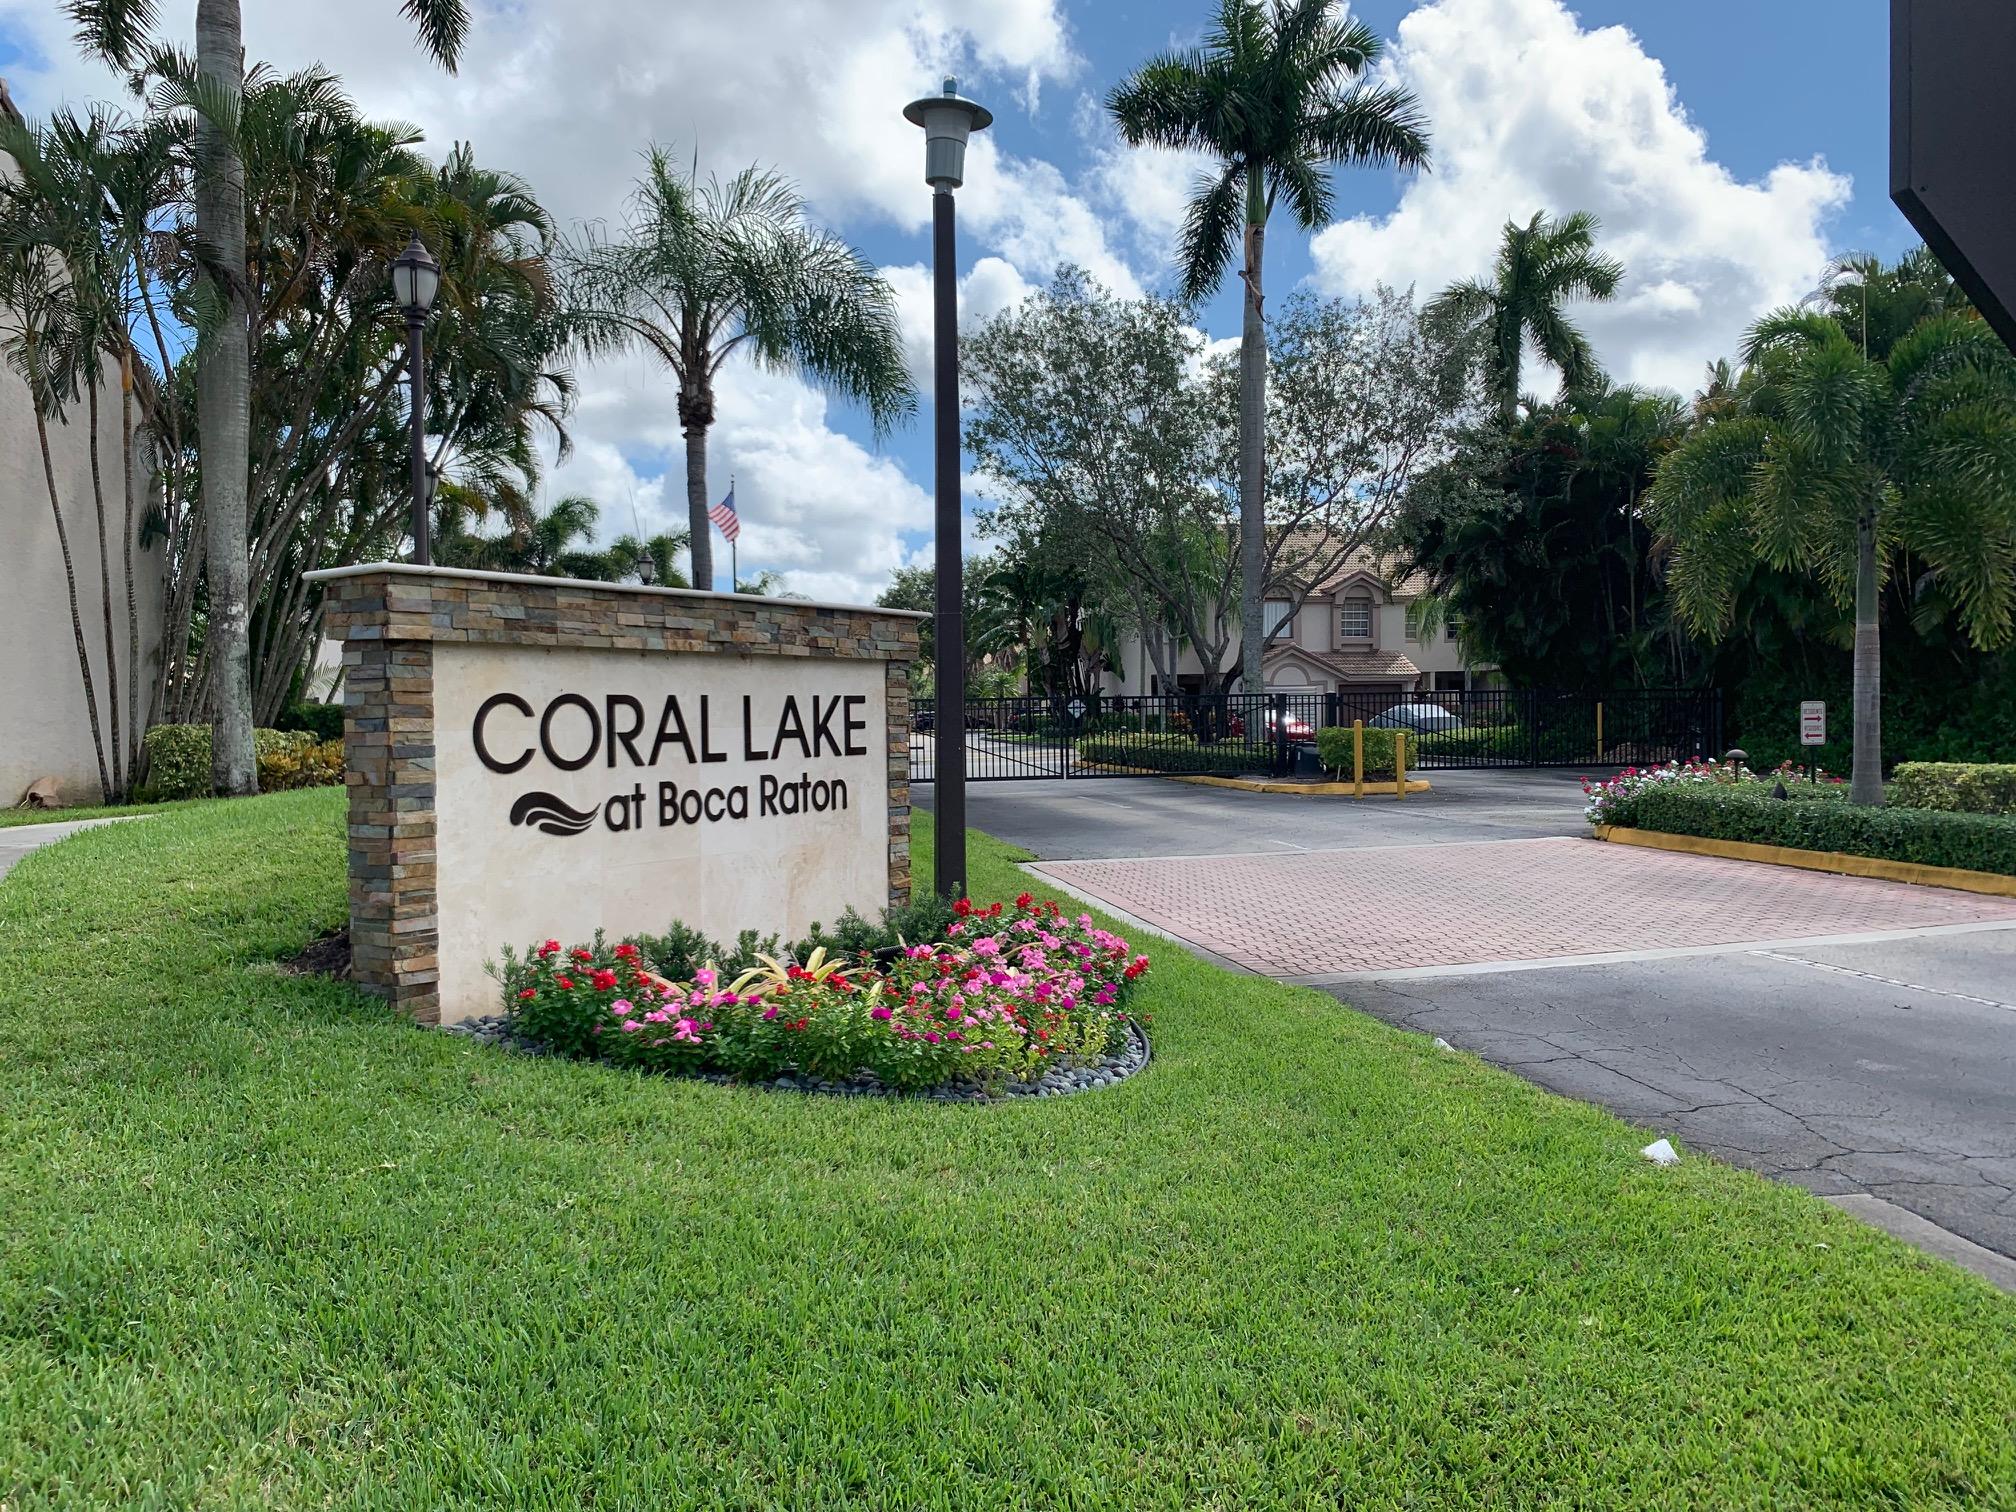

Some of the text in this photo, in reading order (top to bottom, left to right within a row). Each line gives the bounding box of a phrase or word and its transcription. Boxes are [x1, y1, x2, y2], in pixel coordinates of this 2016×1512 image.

[472, 692, 867, 775] CORAL LAKE
[604, 772, 848, 833] at Boca Raton
